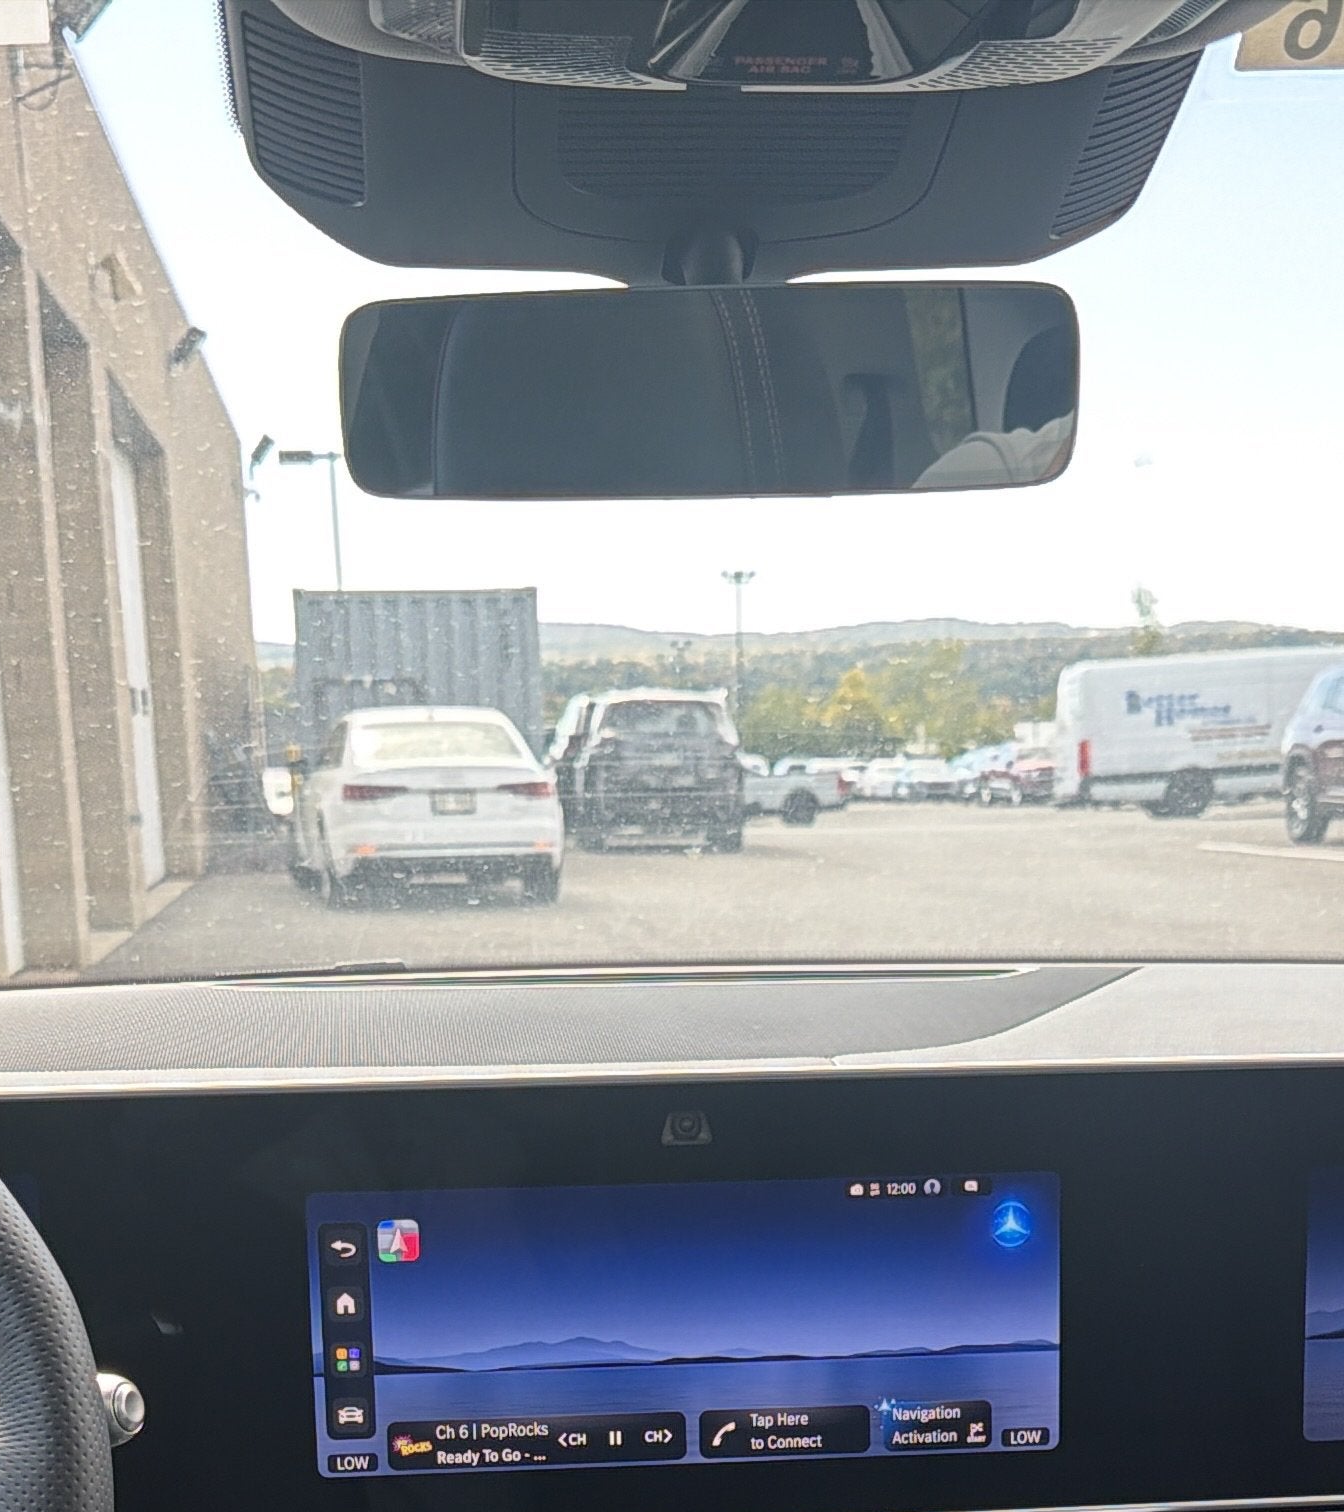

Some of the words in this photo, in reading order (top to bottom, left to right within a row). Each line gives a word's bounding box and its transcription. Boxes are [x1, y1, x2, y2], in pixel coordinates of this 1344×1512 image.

[886, 1182, 917, 1195] 12:00
[749, 1413, 774, 1429] Tap
[777, 1412, 809, 1427] Here
[892, 1405, 961, 1423] Navigation
[435, 1424, 456, 1440] Ch
[459, 1424, 469, 1439] 6
[481, 1422, 549, 1440] PopRocks
[891, 1428, 958, 1446] Activation
[1010, 1430, 1042, 1445] LOW
[750, 1436, 764, 1450] to
[767, 1434, 823, 1450] Connect
[336, 1456, 370, 1471] LOW
[436, 1449, 480, 1467] Ready
[483, 1449, 498, 1463] To
[502, 1448, 522, 1462] Go
